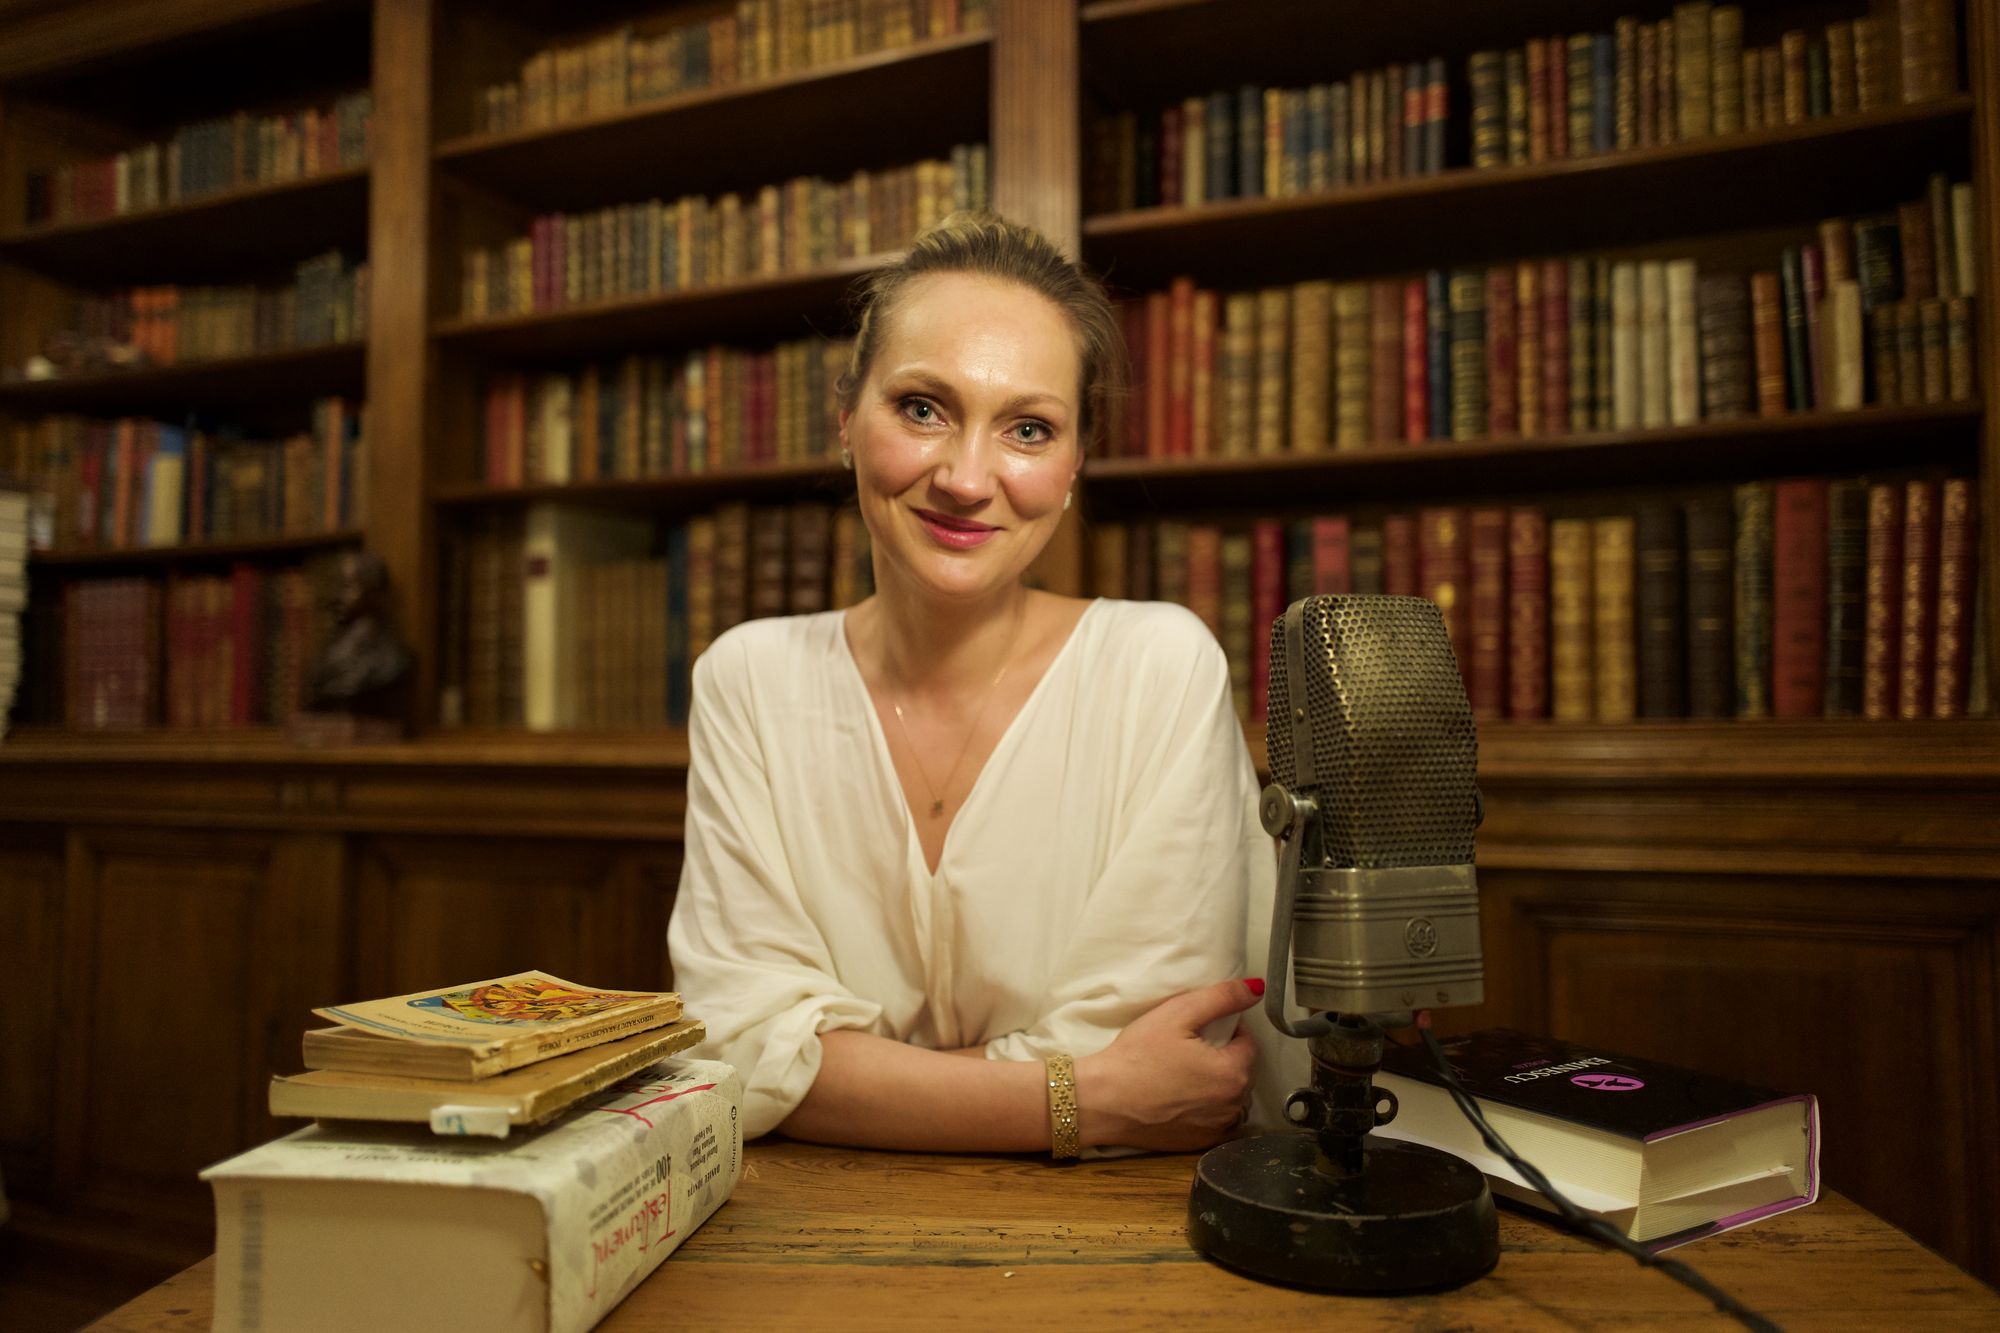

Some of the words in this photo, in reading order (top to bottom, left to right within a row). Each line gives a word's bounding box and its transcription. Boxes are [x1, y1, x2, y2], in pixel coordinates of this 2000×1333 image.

[1504, 1057, 1612, 1083] EMINESCU
[656, 1153, 671, 1184] 400
[705, 1163, 720, 1184] DANIEL
[588, 1179, 676, 1298] Testament
